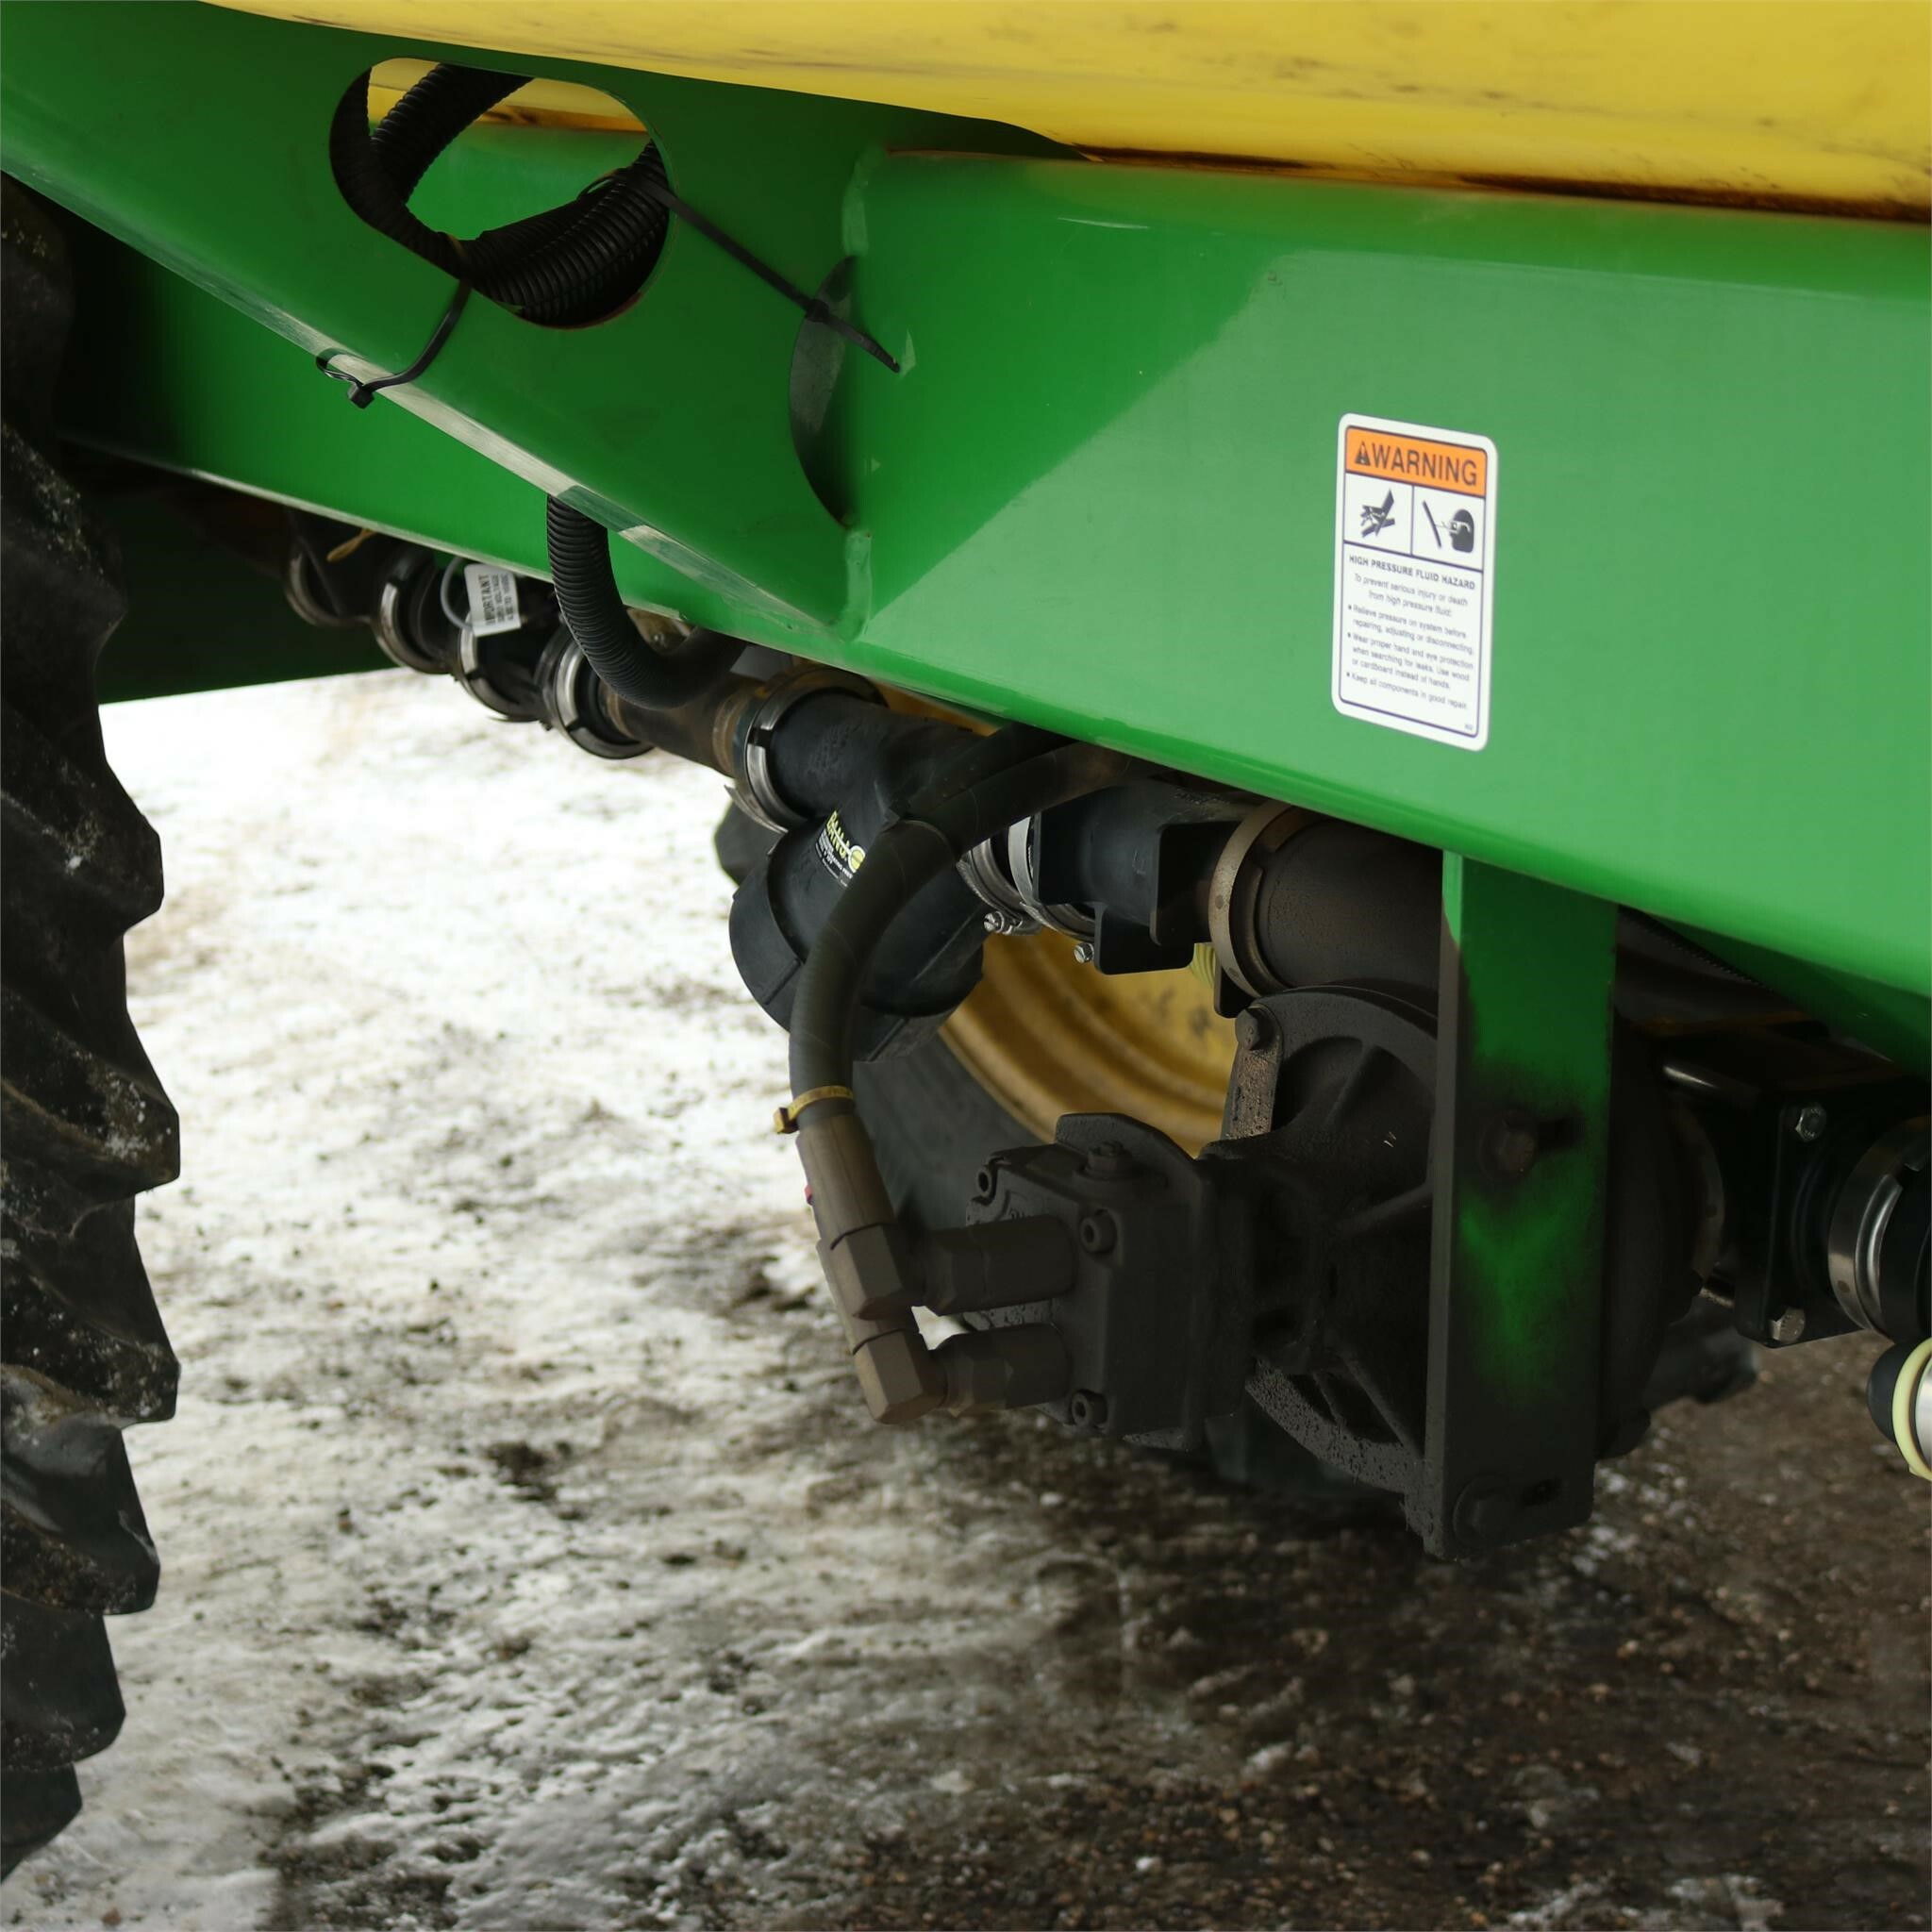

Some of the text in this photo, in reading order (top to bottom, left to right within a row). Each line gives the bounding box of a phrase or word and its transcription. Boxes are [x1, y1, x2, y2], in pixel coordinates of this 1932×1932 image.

[1371, 443, 1477, 487] WARNING
[1349, 555, 1475, 590] HIGH PRESSURE FLUID HAZARD
[1355, 574, 1361, 582] To
[1363, 576, 1389, 591] prevent
[1391, 583, 1415, 594] serious
[1417, 589, 1437, 601] injury
[1448, 595, 1468, 607] death
[1369, 591, 1384, 601] from
[1386, 594, 1401, 608] high
[1403, 600, 1433, 614] pressure
[1353, 605, 1376, 618] Relieve
[1378, 612, 1407, 626] pressure
[1419, 622, 1442, 635] system
[1444, 627, 1466, 639] before
[1385, 626, 1415, 641] adjusting
[1353, 634, 1474, 671] Wear proper hand and eye protection
[1353, 646, 1370, 657] when
[1371, 651, 1403, 667] searching
[1405, 659, 1413, 668] for
[1437, 667, 1450, 677] Use
[1452, 671, 1470, 682] wood
[1360, 660, 1393, 675] cardboard
[1395, 669, 1419, 682] instead
[1421, 675, 1427, 683] of
[1351, 673, 1368, 685] Keep
[1369, 677, 1377, 687] all
[1378, 680, 1419, 699] components
[1421, 691, 1427, 699] in
[1428, 693, 1446, 707] good
